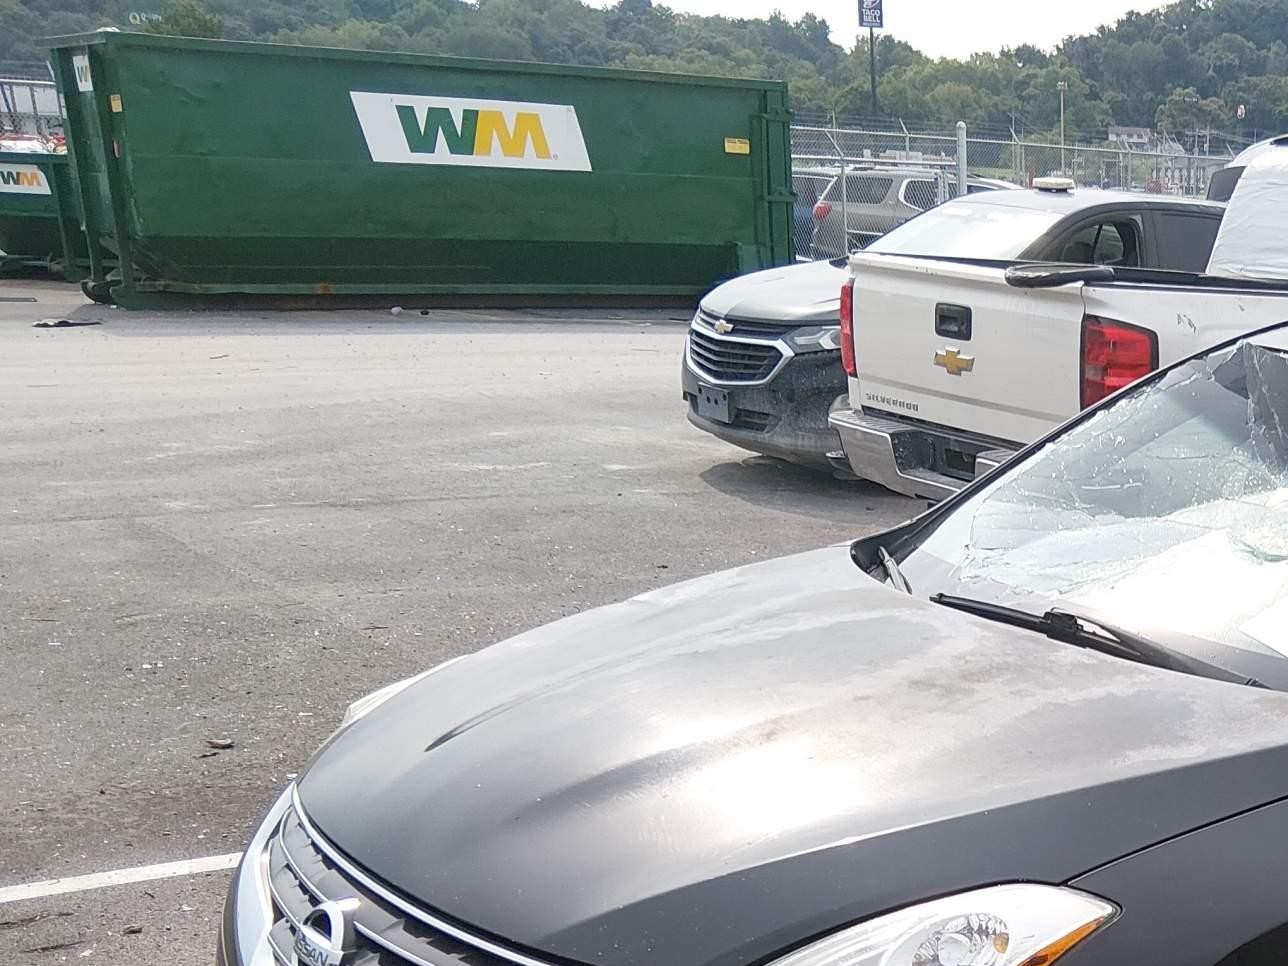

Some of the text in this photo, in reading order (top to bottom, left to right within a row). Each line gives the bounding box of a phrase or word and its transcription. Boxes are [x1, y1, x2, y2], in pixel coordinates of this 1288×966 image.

[395, 104, 553, 161] WM
[0, 170, 41, 188] WM
[865, 392, 919, 412] SILVERADO
